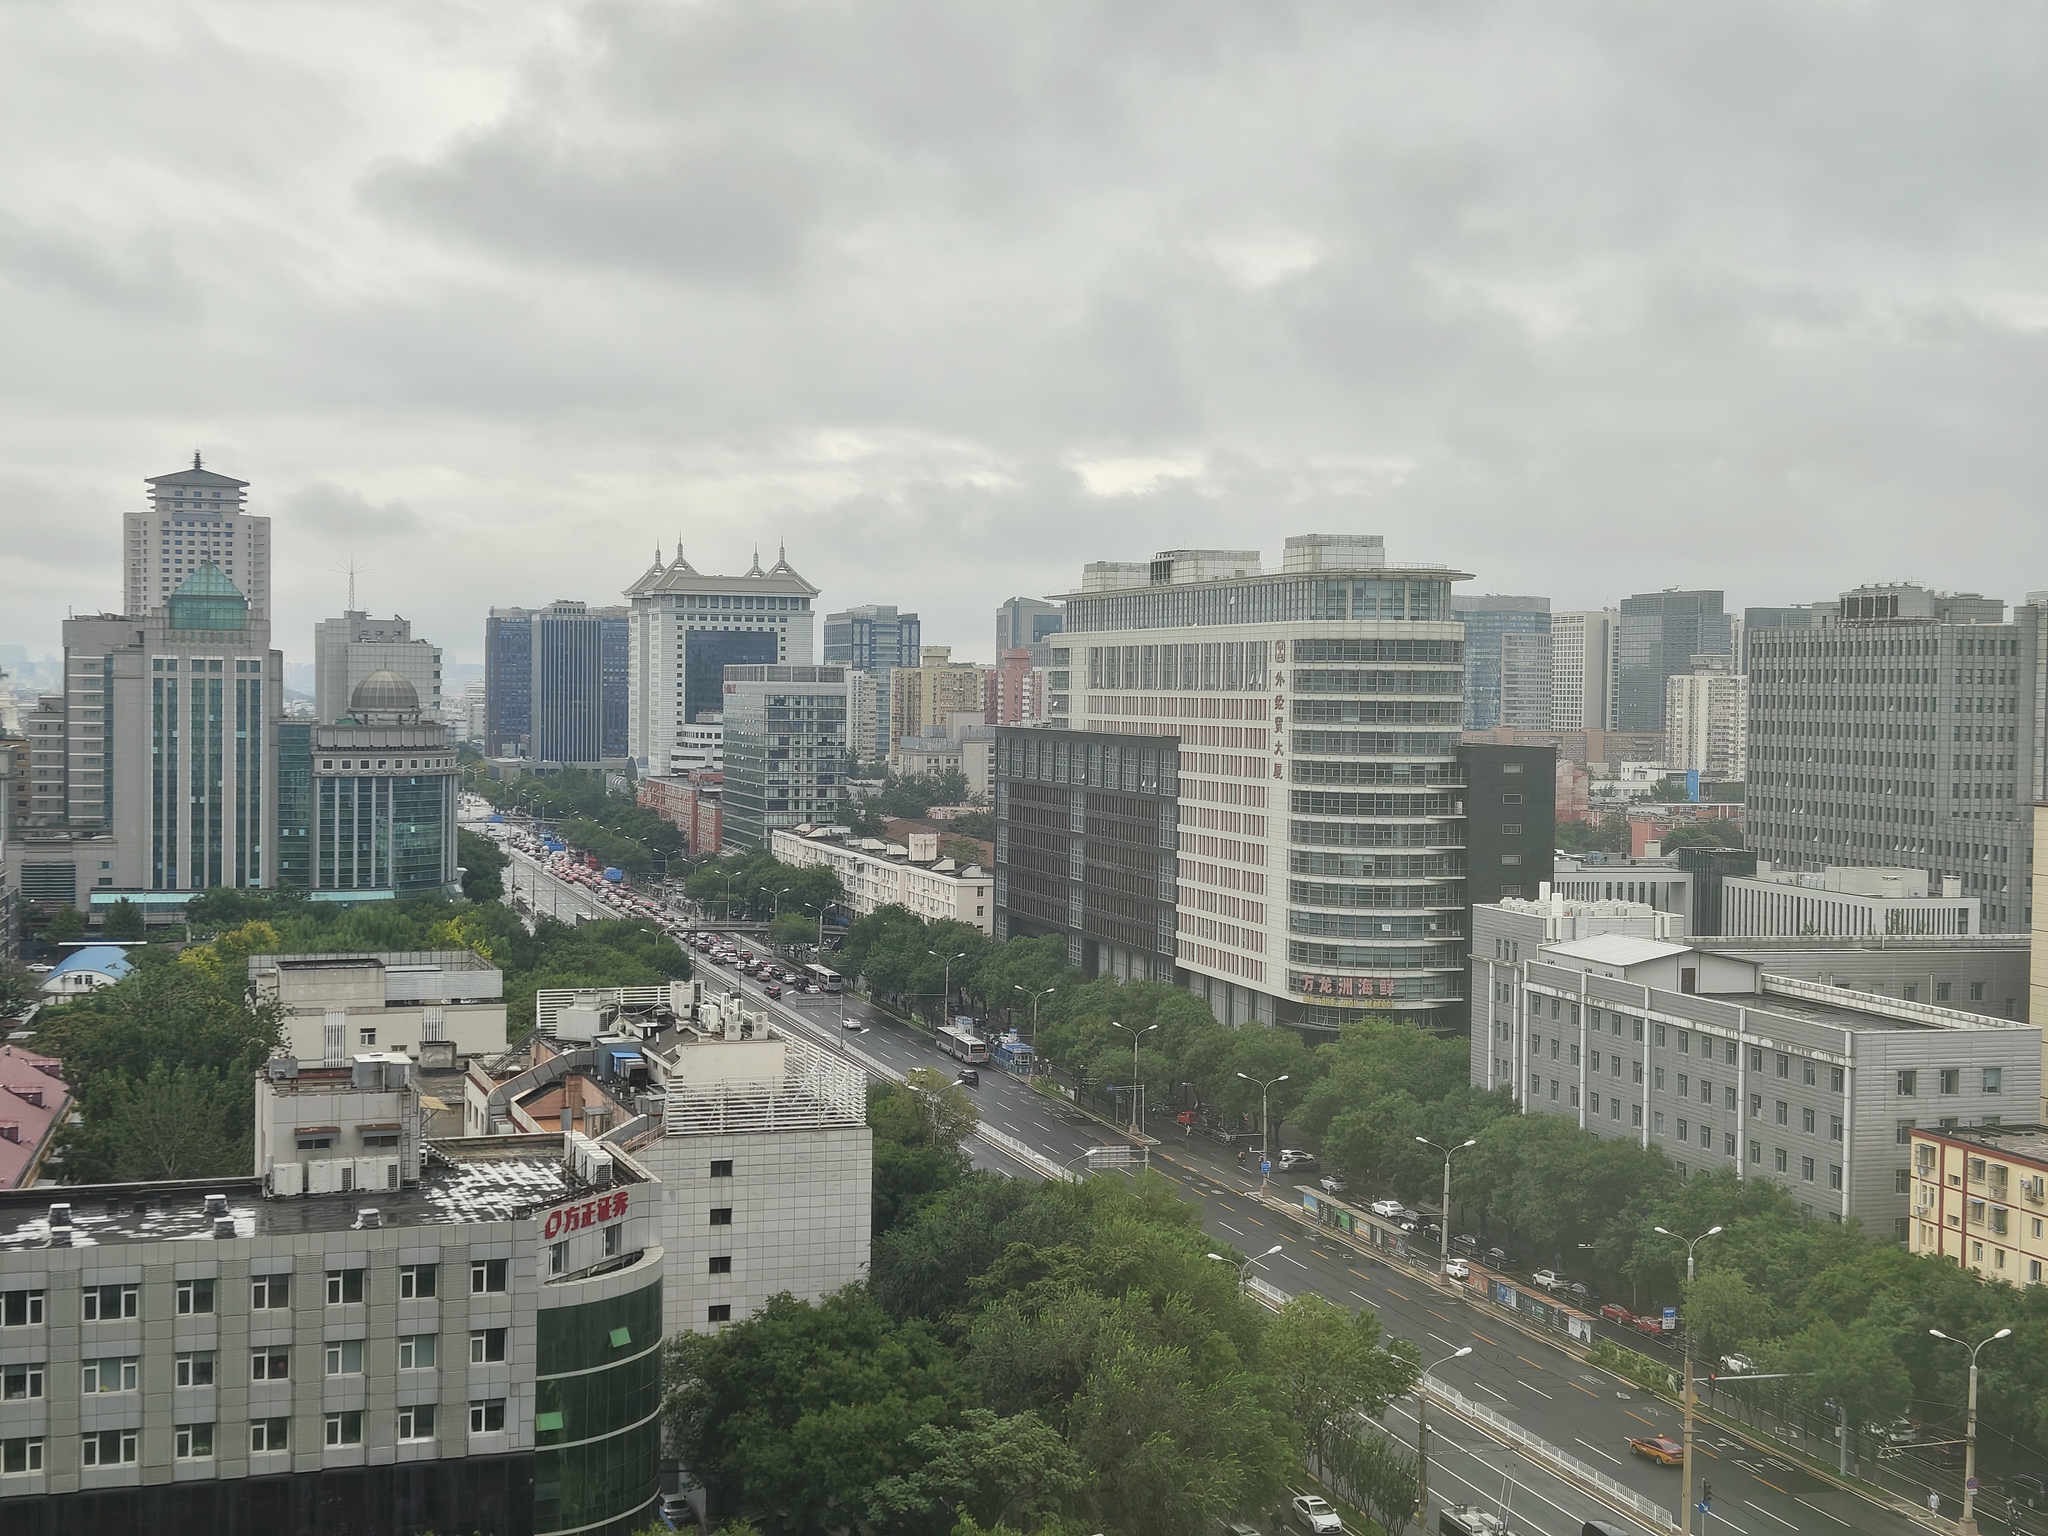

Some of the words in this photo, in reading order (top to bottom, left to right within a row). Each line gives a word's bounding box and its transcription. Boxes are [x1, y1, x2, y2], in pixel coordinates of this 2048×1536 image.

[1302, 974, 1395, 996] 万龙洲海鲜
[564, 1191, 628, 1233] 方正证券
